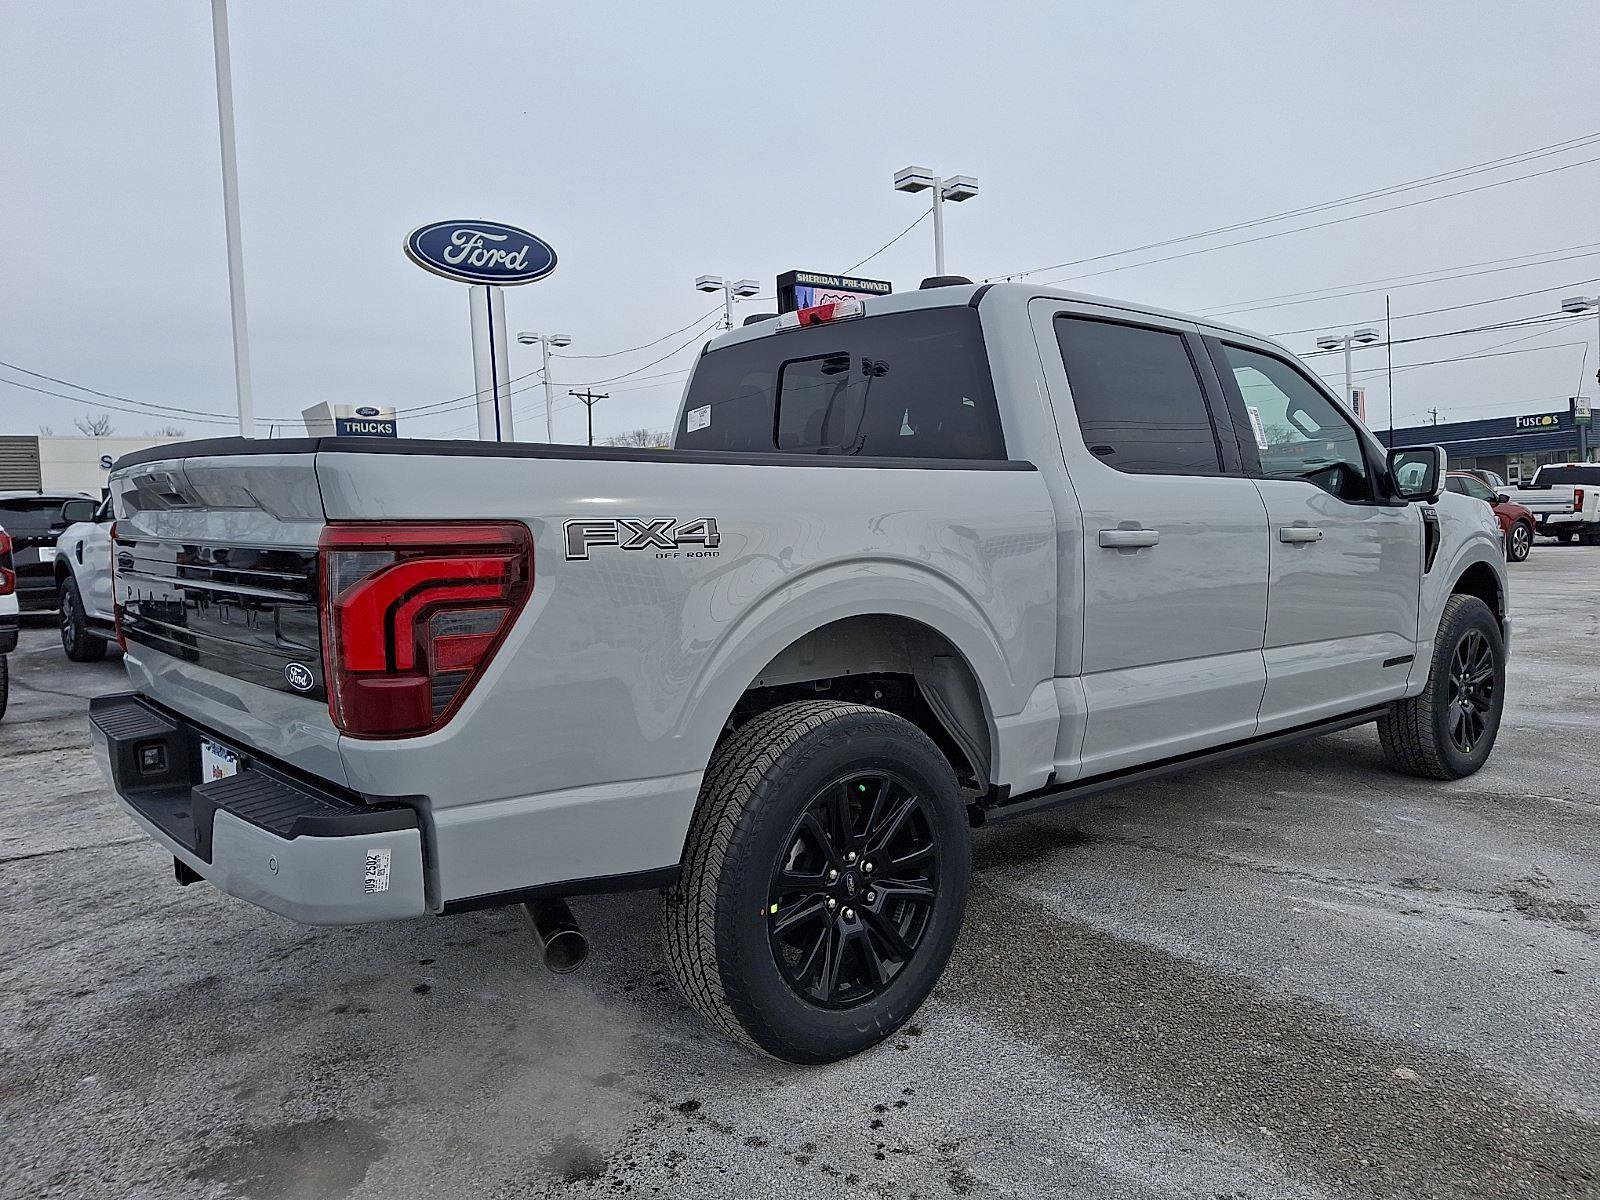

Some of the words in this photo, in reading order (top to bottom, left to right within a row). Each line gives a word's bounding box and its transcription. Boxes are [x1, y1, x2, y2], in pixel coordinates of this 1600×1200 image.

[443, 229, 530, 271] Ford
[796, 273, 840, 286] SHERIDAN
[842, 279, 890, 292] PRE-OWNED
[343, 422, 393, 434] TRUCKS
[563, 518, 721, 562] FX4
[290, 666, 307, 687] Ford
[366, 855, 377, 876] 2502
